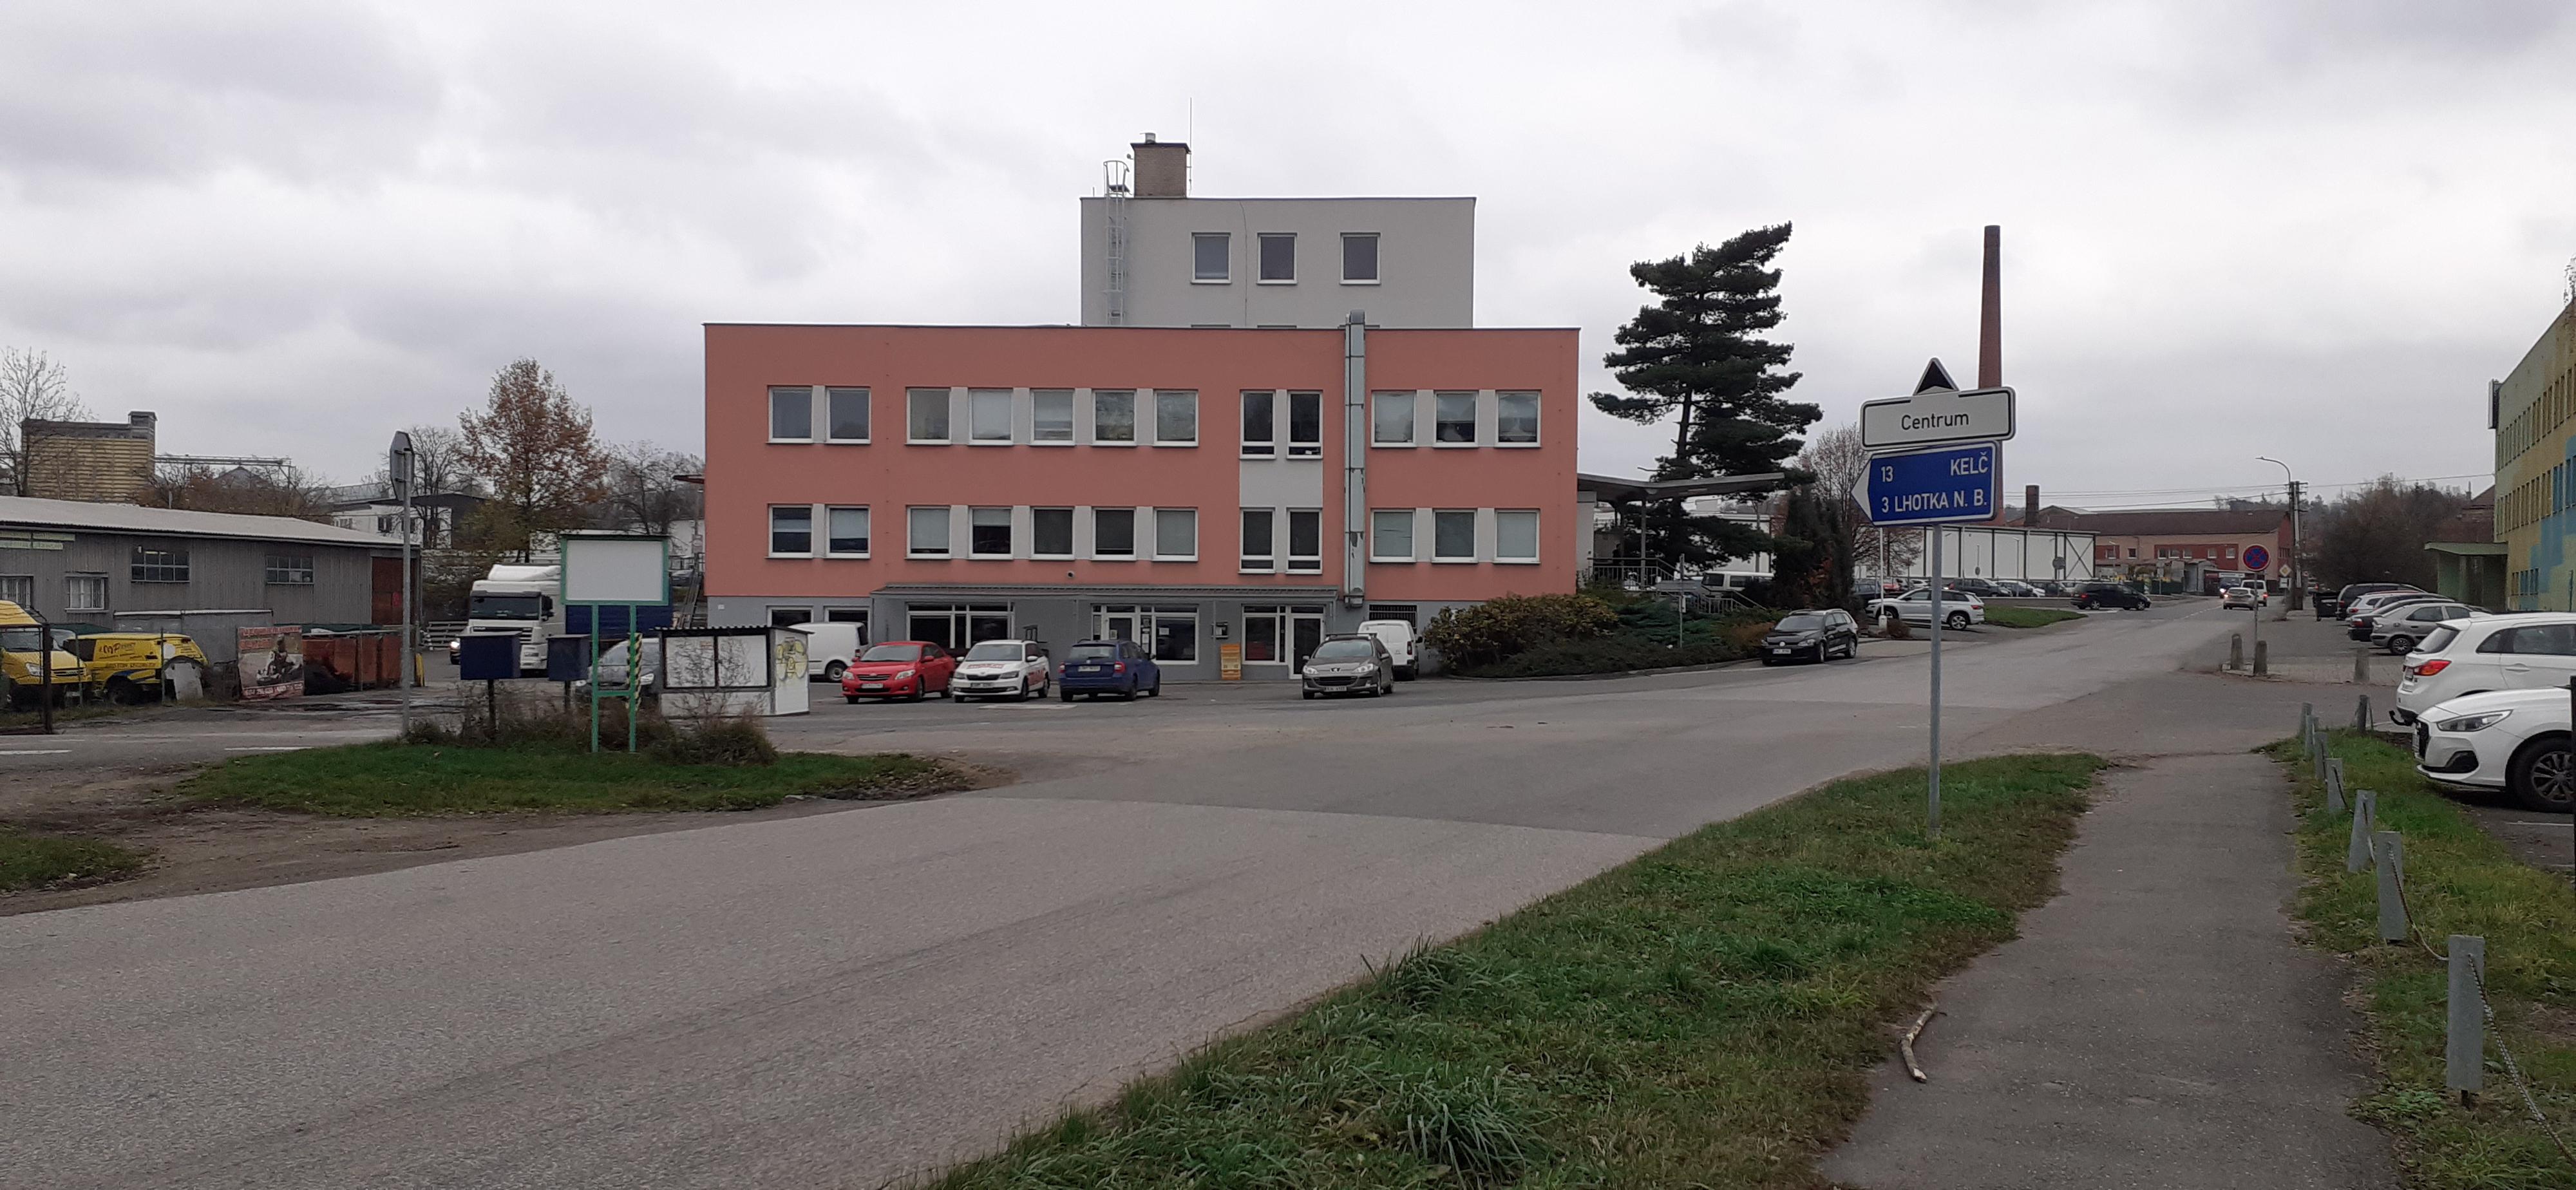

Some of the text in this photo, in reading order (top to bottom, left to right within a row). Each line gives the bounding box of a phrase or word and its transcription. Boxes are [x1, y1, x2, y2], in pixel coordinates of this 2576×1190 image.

[1901, 413, 1969, 430] Centrum
[1881, 451, 1989, 482] 13 KELČ
[1882, 488, 1987, 513] 3 LHOTKA N. B.
